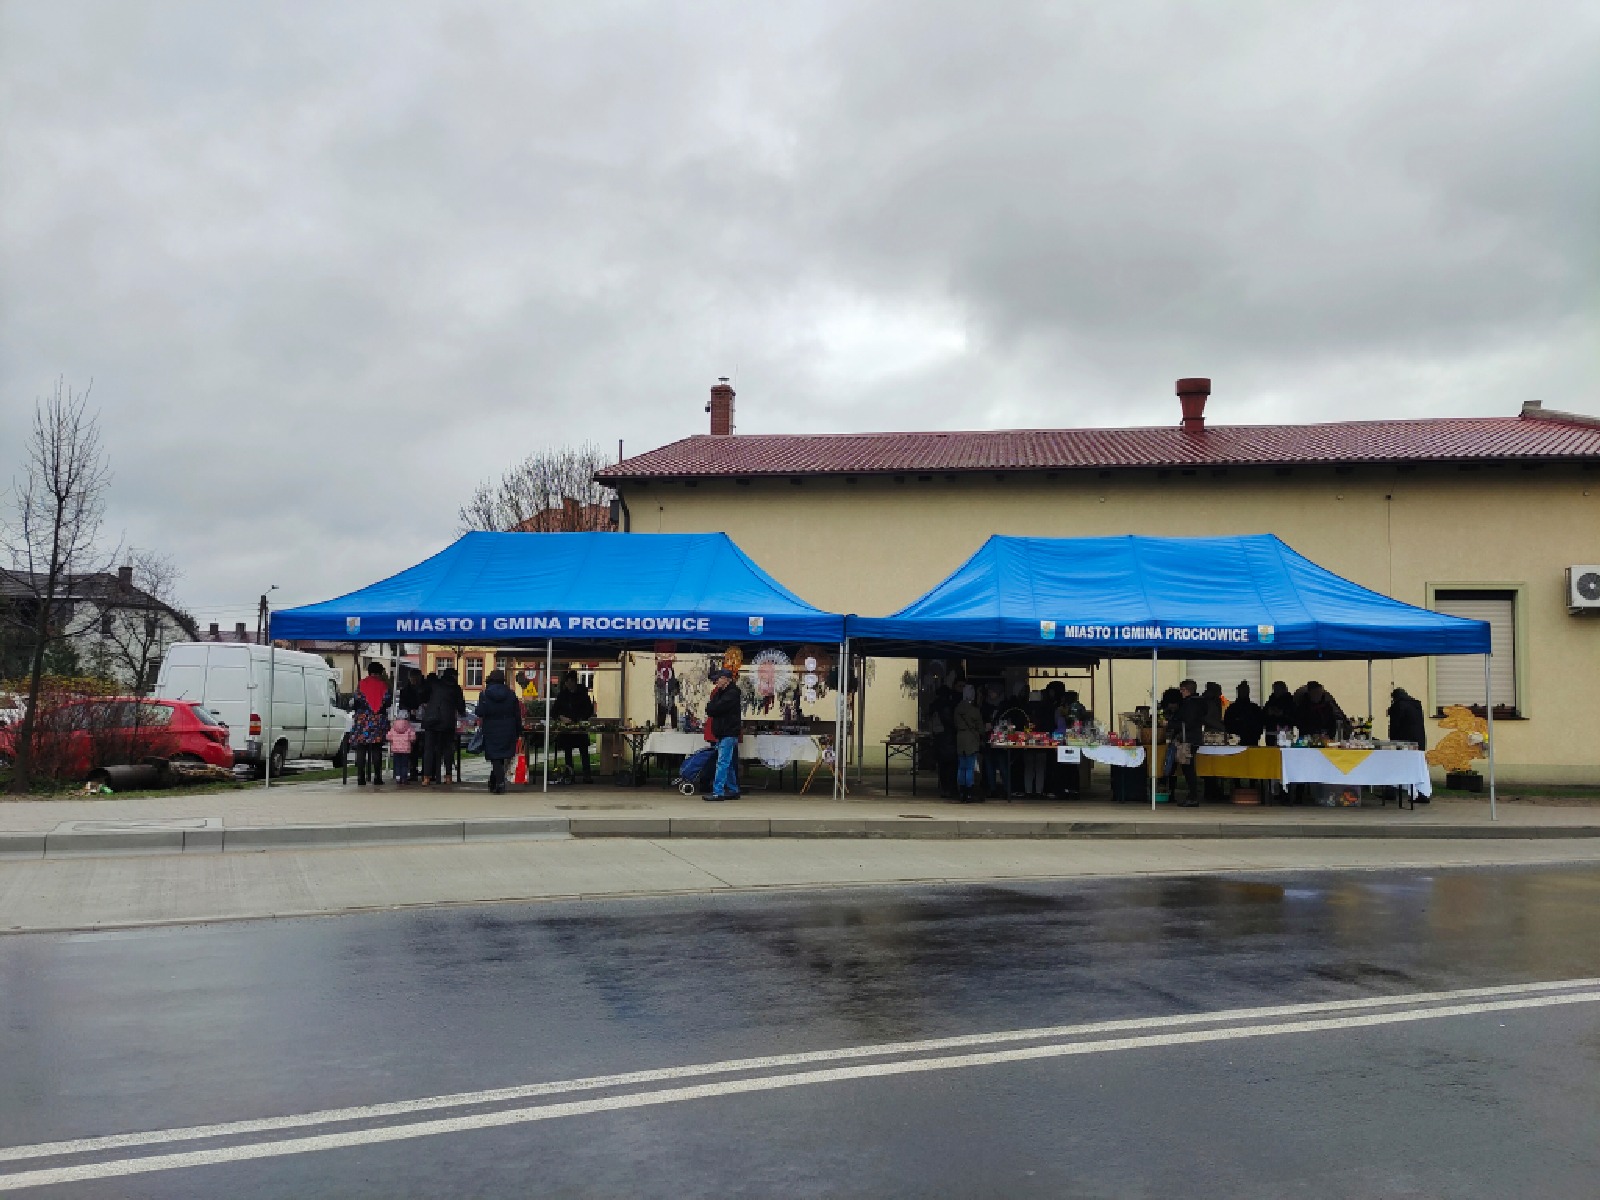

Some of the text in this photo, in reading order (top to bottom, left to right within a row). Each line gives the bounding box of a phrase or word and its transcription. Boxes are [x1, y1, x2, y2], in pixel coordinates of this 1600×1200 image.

[396, 616, 710, 632] MIASTO I GMINA PROCHOWICE
[1064, 625, 1111, 639] MIASTO
[1121, 626, 1162, 640] GMINA
[1165, 627, 1249, 643] PROCHOWICE
